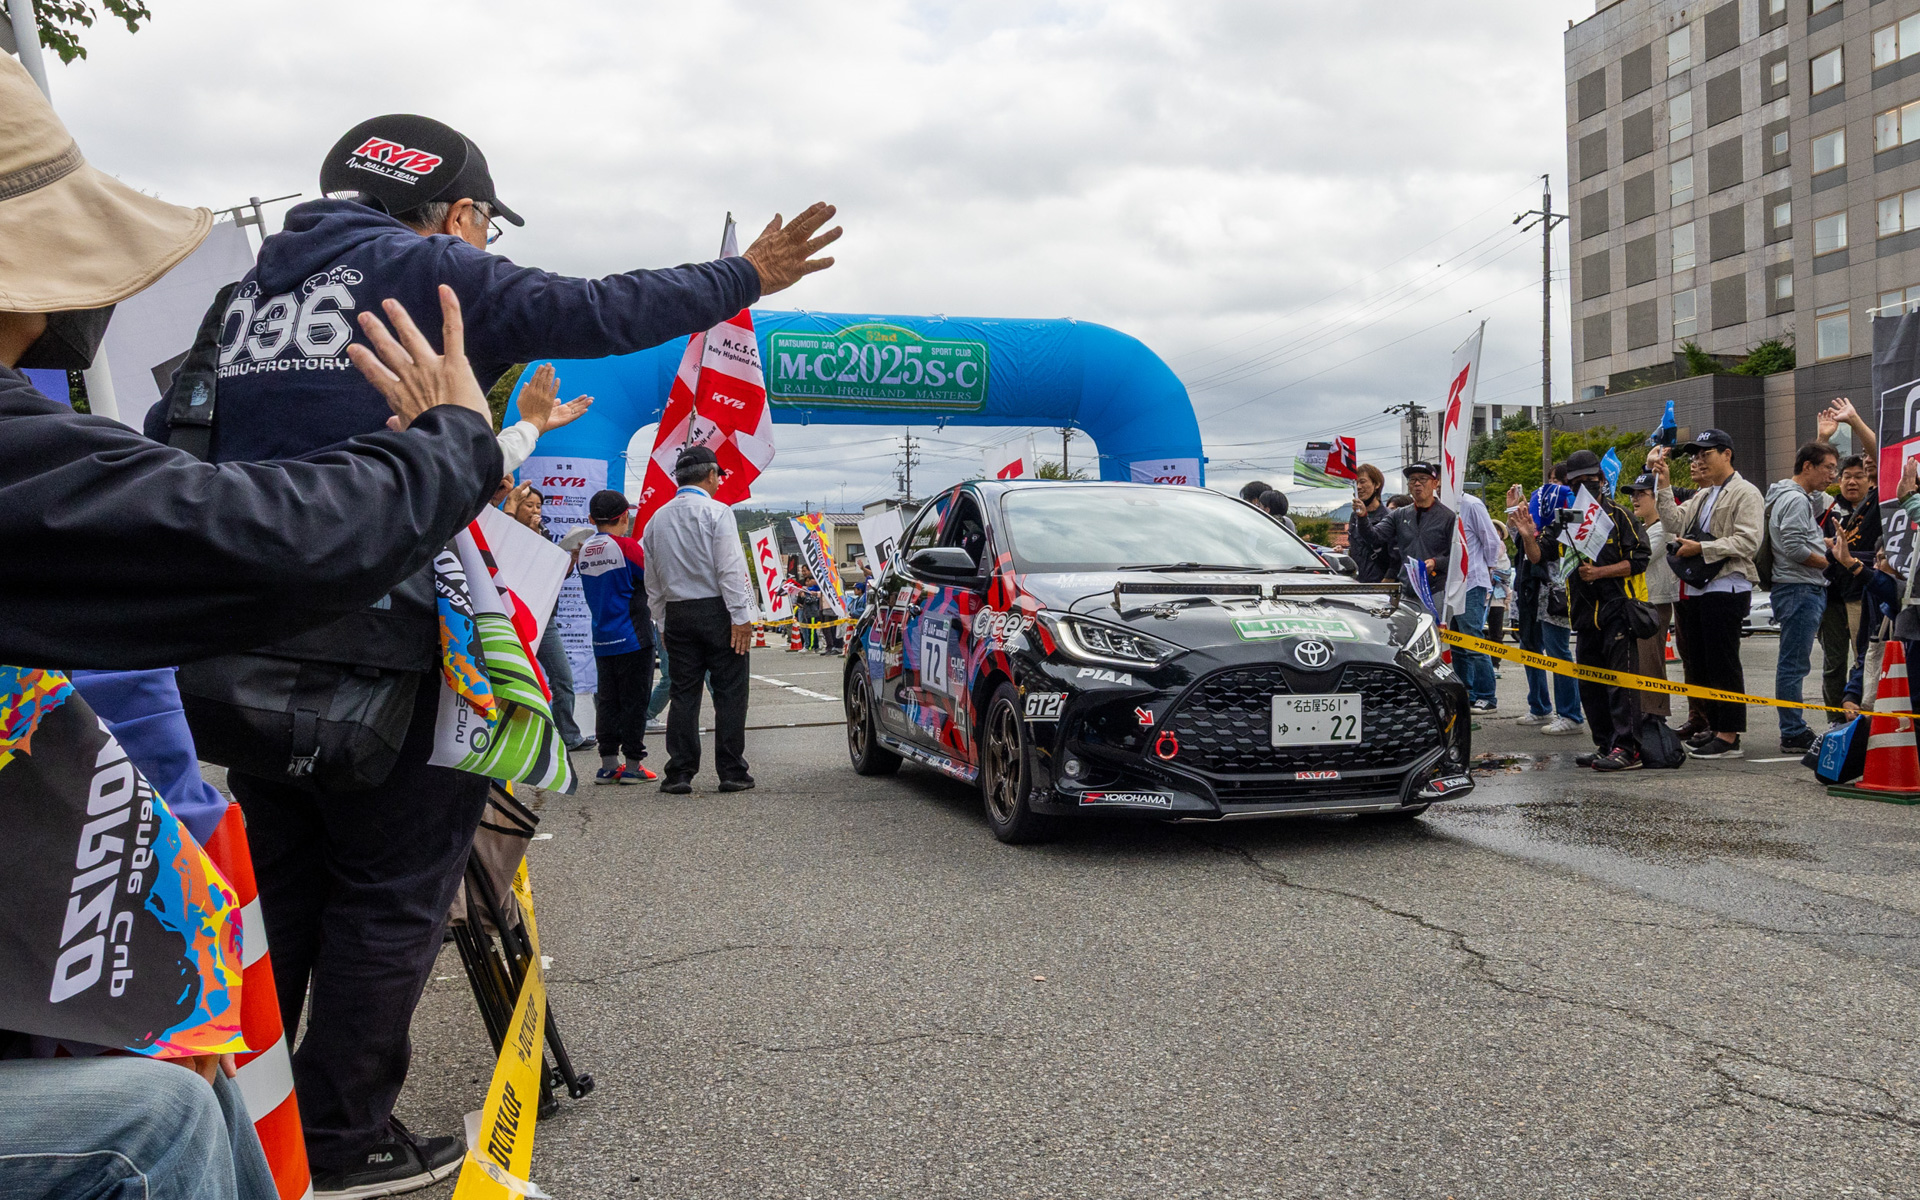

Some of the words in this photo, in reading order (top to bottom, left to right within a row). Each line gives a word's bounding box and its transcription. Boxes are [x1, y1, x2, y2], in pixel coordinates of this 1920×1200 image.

[351, 136, 443, 175] KYB
[363, 161, 393, 174] RALLY
[393, 170, 419, 182] TEAM
[866, 330, 898, 342] 52nd
[722, 338, 758, 358] M.C.S.C.
[778, 339, 819, 349] MATSUMOTO
[821, 340, 835, 350] CAR
[708, 344, 722, 356] Rally
[722, 350, 750, 366] Highland
[931, 347, 952, 356] SPORT
[955, 348, 972, 357] CLUB
[837, 342, 923, 386] 2025
[783, 383, 828, 394] RALLY
[837, 386, 906, 398] HIGHLAND
[915, 389, 972, 401] MASTERS
[711, 392, 746, 410] KYB
[542, 476, 587, 487] KYB
[1153, 475, 1187, 485] KYB
[553, 516, 590, 524] SUBAR
[590, 558, 617, 567] SUBARU
[973, 604, 1035, 641] Creer
[1479, 642, 1508, 655] DUNLOP
[926, 641, 941, 685] 72
[1526, 655, 1558, 668] DUNLOP
[1076, 667, 1133, 686] PIAA
[1578, 668, 1618, 682] DUNLOP
[1644, 680, 1688, 693] DUNLOP
[1025, 692, 1068, 717] GT2i
[1719, 692, 1769, 705] DUNLOP
[1278, 723, 1289, 736] ゆ
[1330, 715, 1357, 740] 22
[1104, 793, 1167, 805] YOKOHAMA
[516, 993, 537, 1059] DUNLOP
[487, 1080, 523, 1172] DUNLOP
[367, 1151, 394, 1164] FILA
